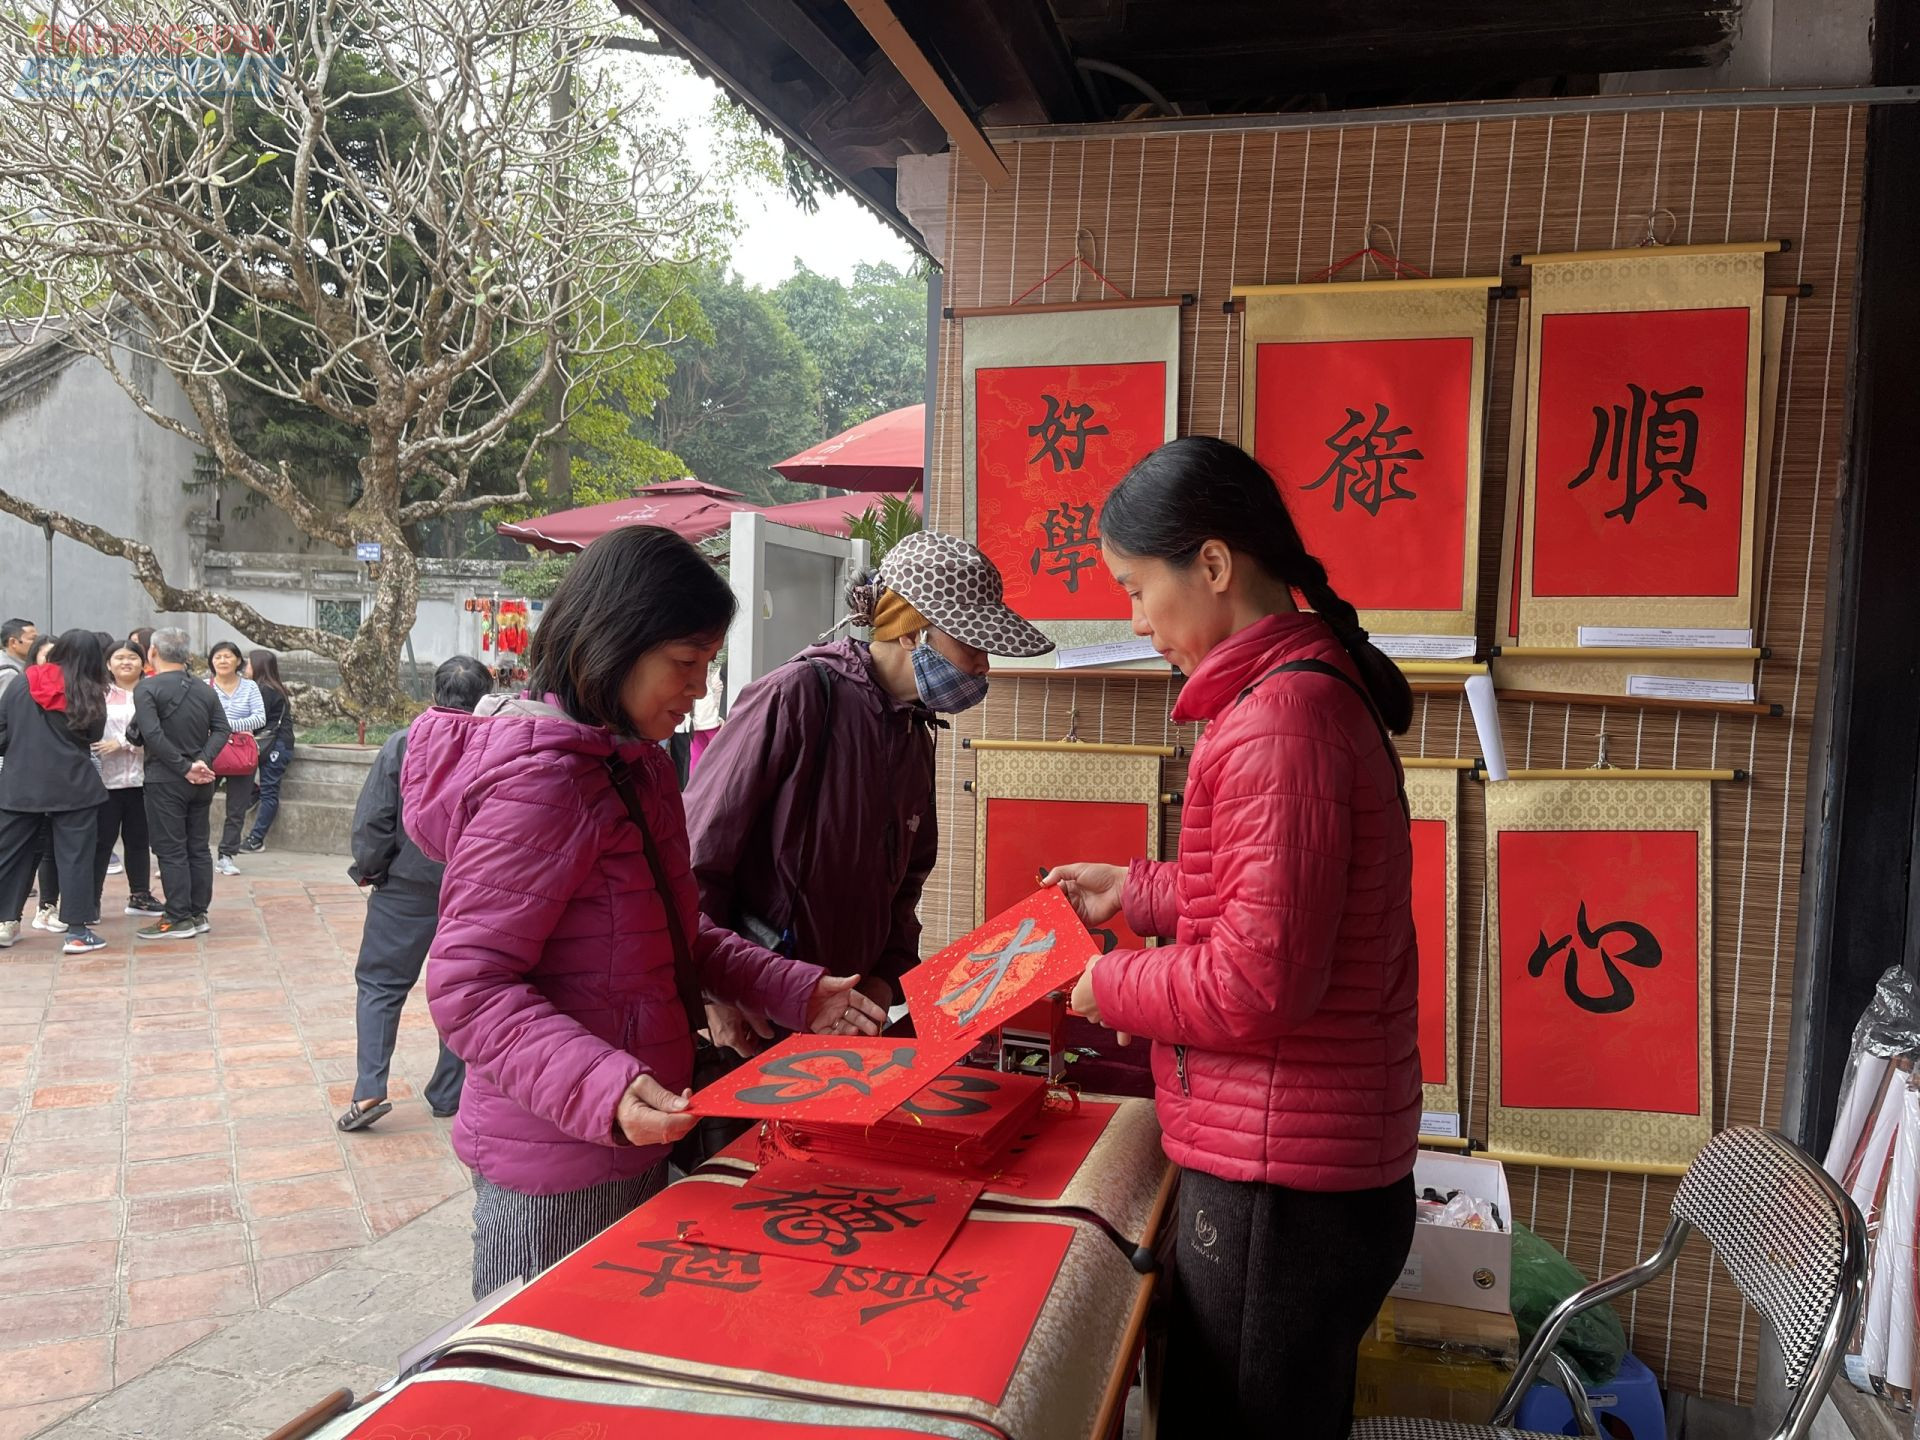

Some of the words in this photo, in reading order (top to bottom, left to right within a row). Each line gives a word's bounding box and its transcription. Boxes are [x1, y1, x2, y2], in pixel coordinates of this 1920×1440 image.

[1029, 395, 1108, 594] 好學
[1567, 383, 1708, 524] 順
[1527, 899, 1663, 1014] 心
